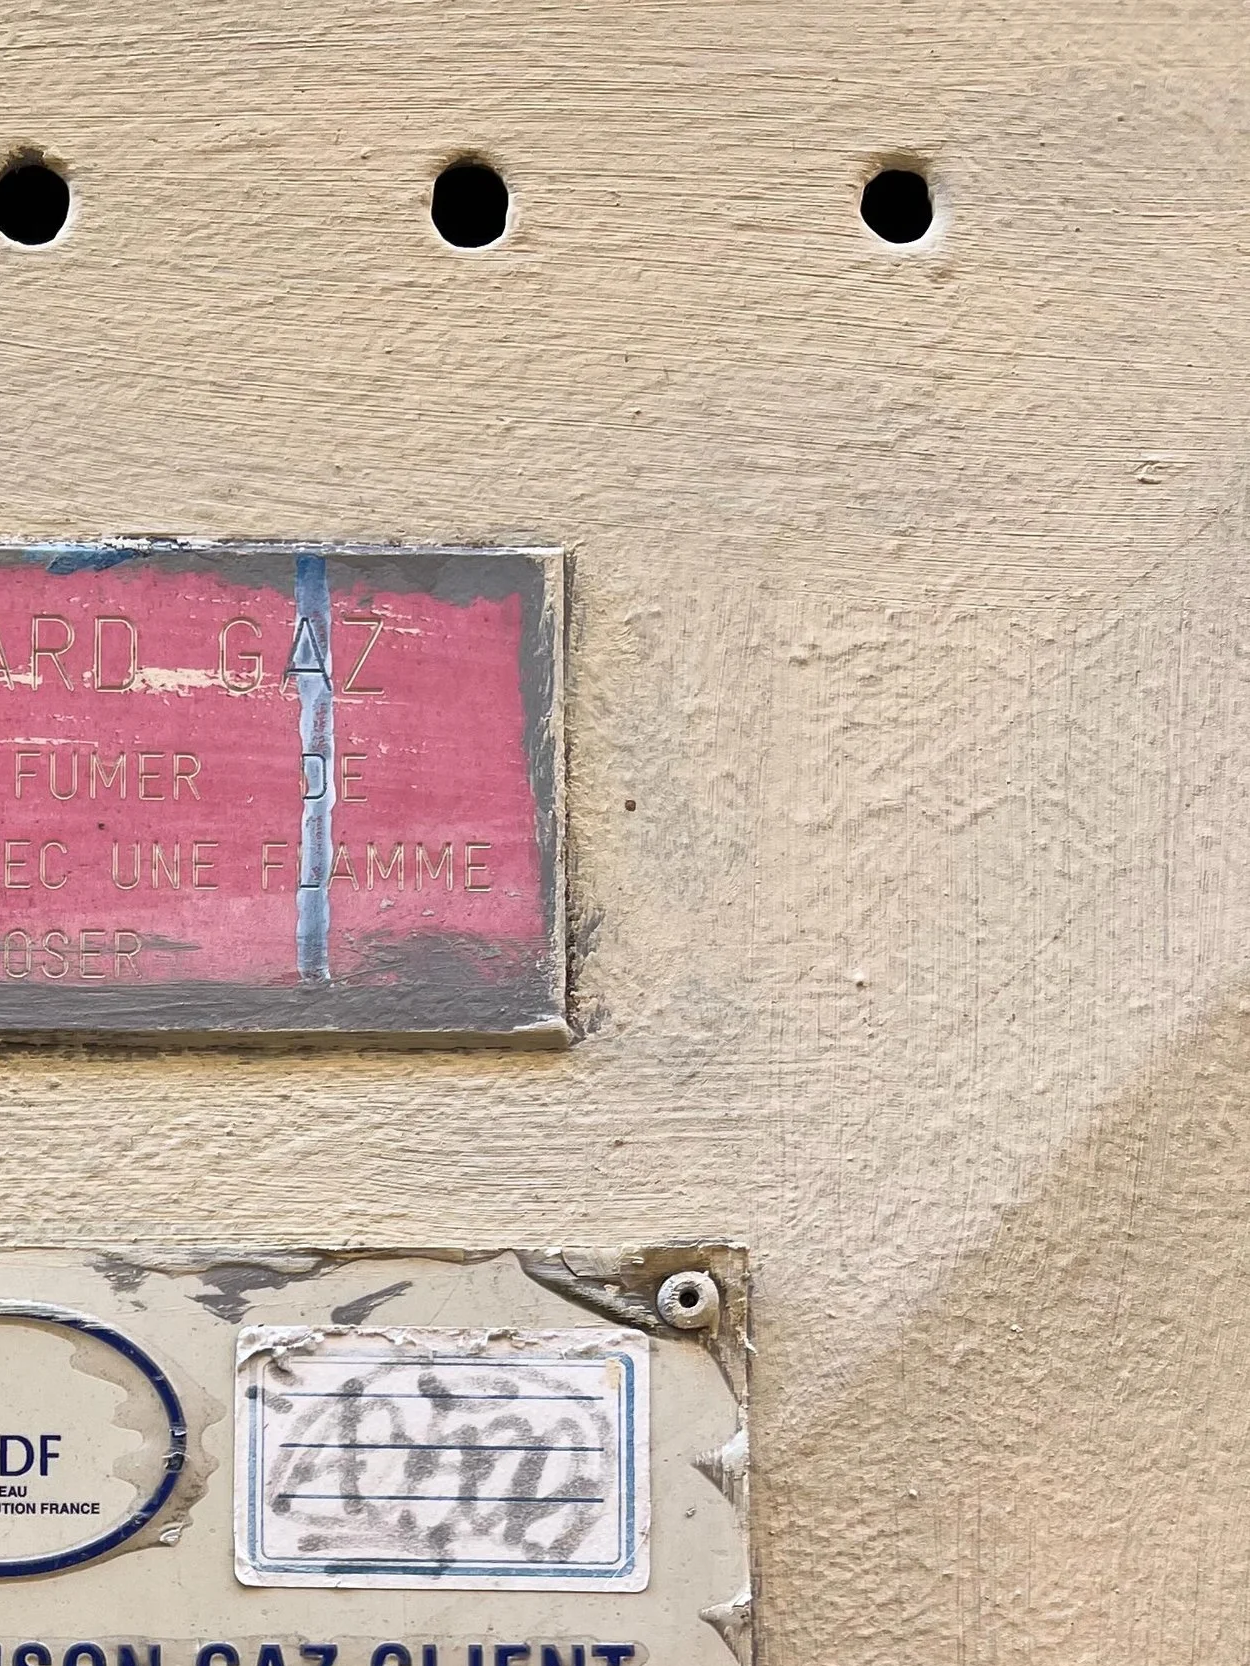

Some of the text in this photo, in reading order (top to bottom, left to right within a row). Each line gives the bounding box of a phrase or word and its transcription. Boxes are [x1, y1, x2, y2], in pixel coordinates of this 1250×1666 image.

[218, 614, 386, 696] GAZ
[14, 751, 203, 803] FUMER
[301, 752, 369, 803] DE
[110, 840, 220, 892] UNE
[260, 840, 494, 894] FLAMME
[39, 1502, 101, 1516] FRANCE
